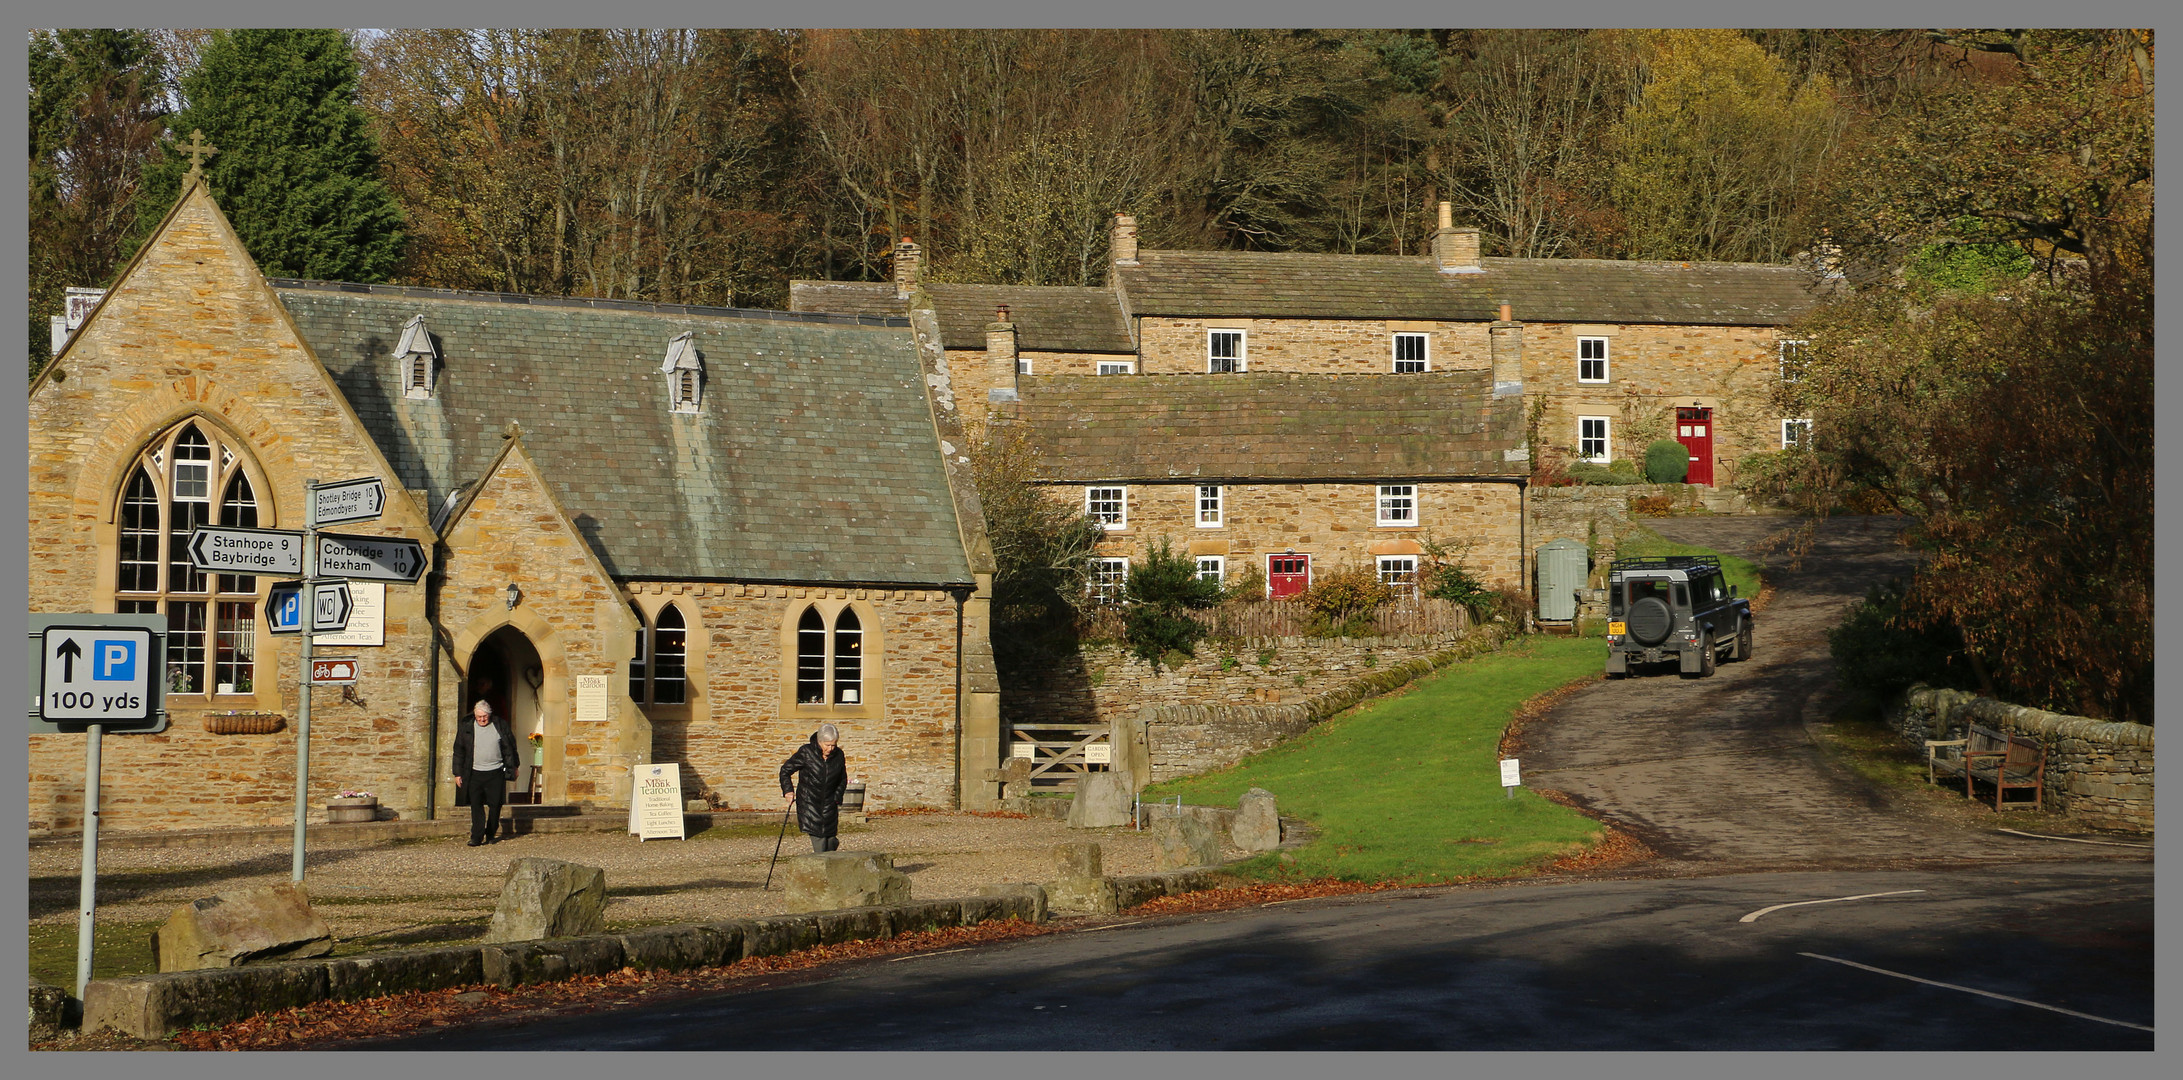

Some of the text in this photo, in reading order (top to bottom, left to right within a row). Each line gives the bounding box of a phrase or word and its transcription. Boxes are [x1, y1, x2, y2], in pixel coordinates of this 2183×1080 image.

[318, 487, 373, 505] Shotley Bridge 10
[318, 500, 373, 517] Edmondbyers 5
[213, 535, 289, 551] Stanhope 9
[324, 543, 404, 559] Corbridge 11
[212, 550, 276, 567] Baybridge
[324, 558, 407, 573] Hexham 10
[285, 596, 296, 622] P
[319, 598, 334, 615] WC
[347, 620, 370, 628] unches
[104, 645, 128, 676] P
[52, 692, 139, 712] 100 yds
[640, 786, 678, 795] Tearoom
[645, 779, 671, 788] Monk
